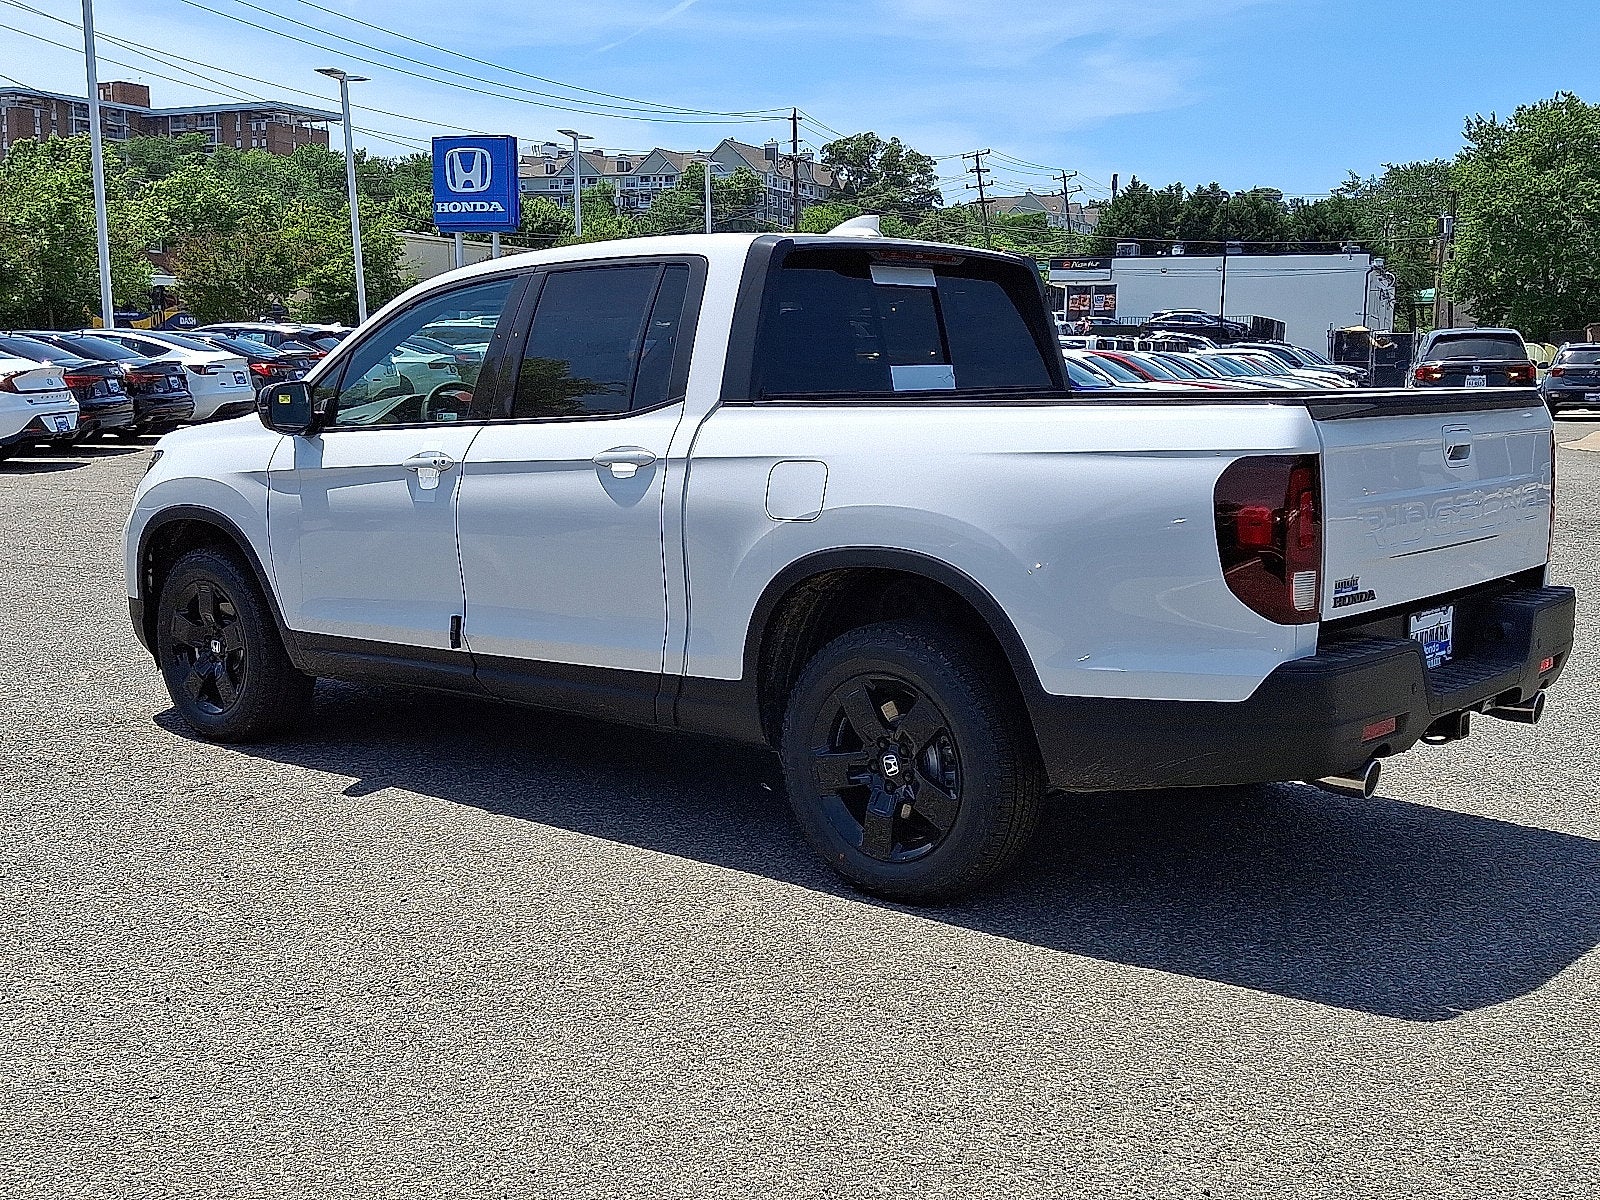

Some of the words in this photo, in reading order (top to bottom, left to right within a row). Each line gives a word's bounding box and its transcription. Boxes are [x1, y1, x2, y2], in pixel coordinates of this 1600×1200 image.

[436, 201, 506, 213] HONDA
[179, 316, 197, 325] DASH
[1331, 589, 1377, 608] HONDA
